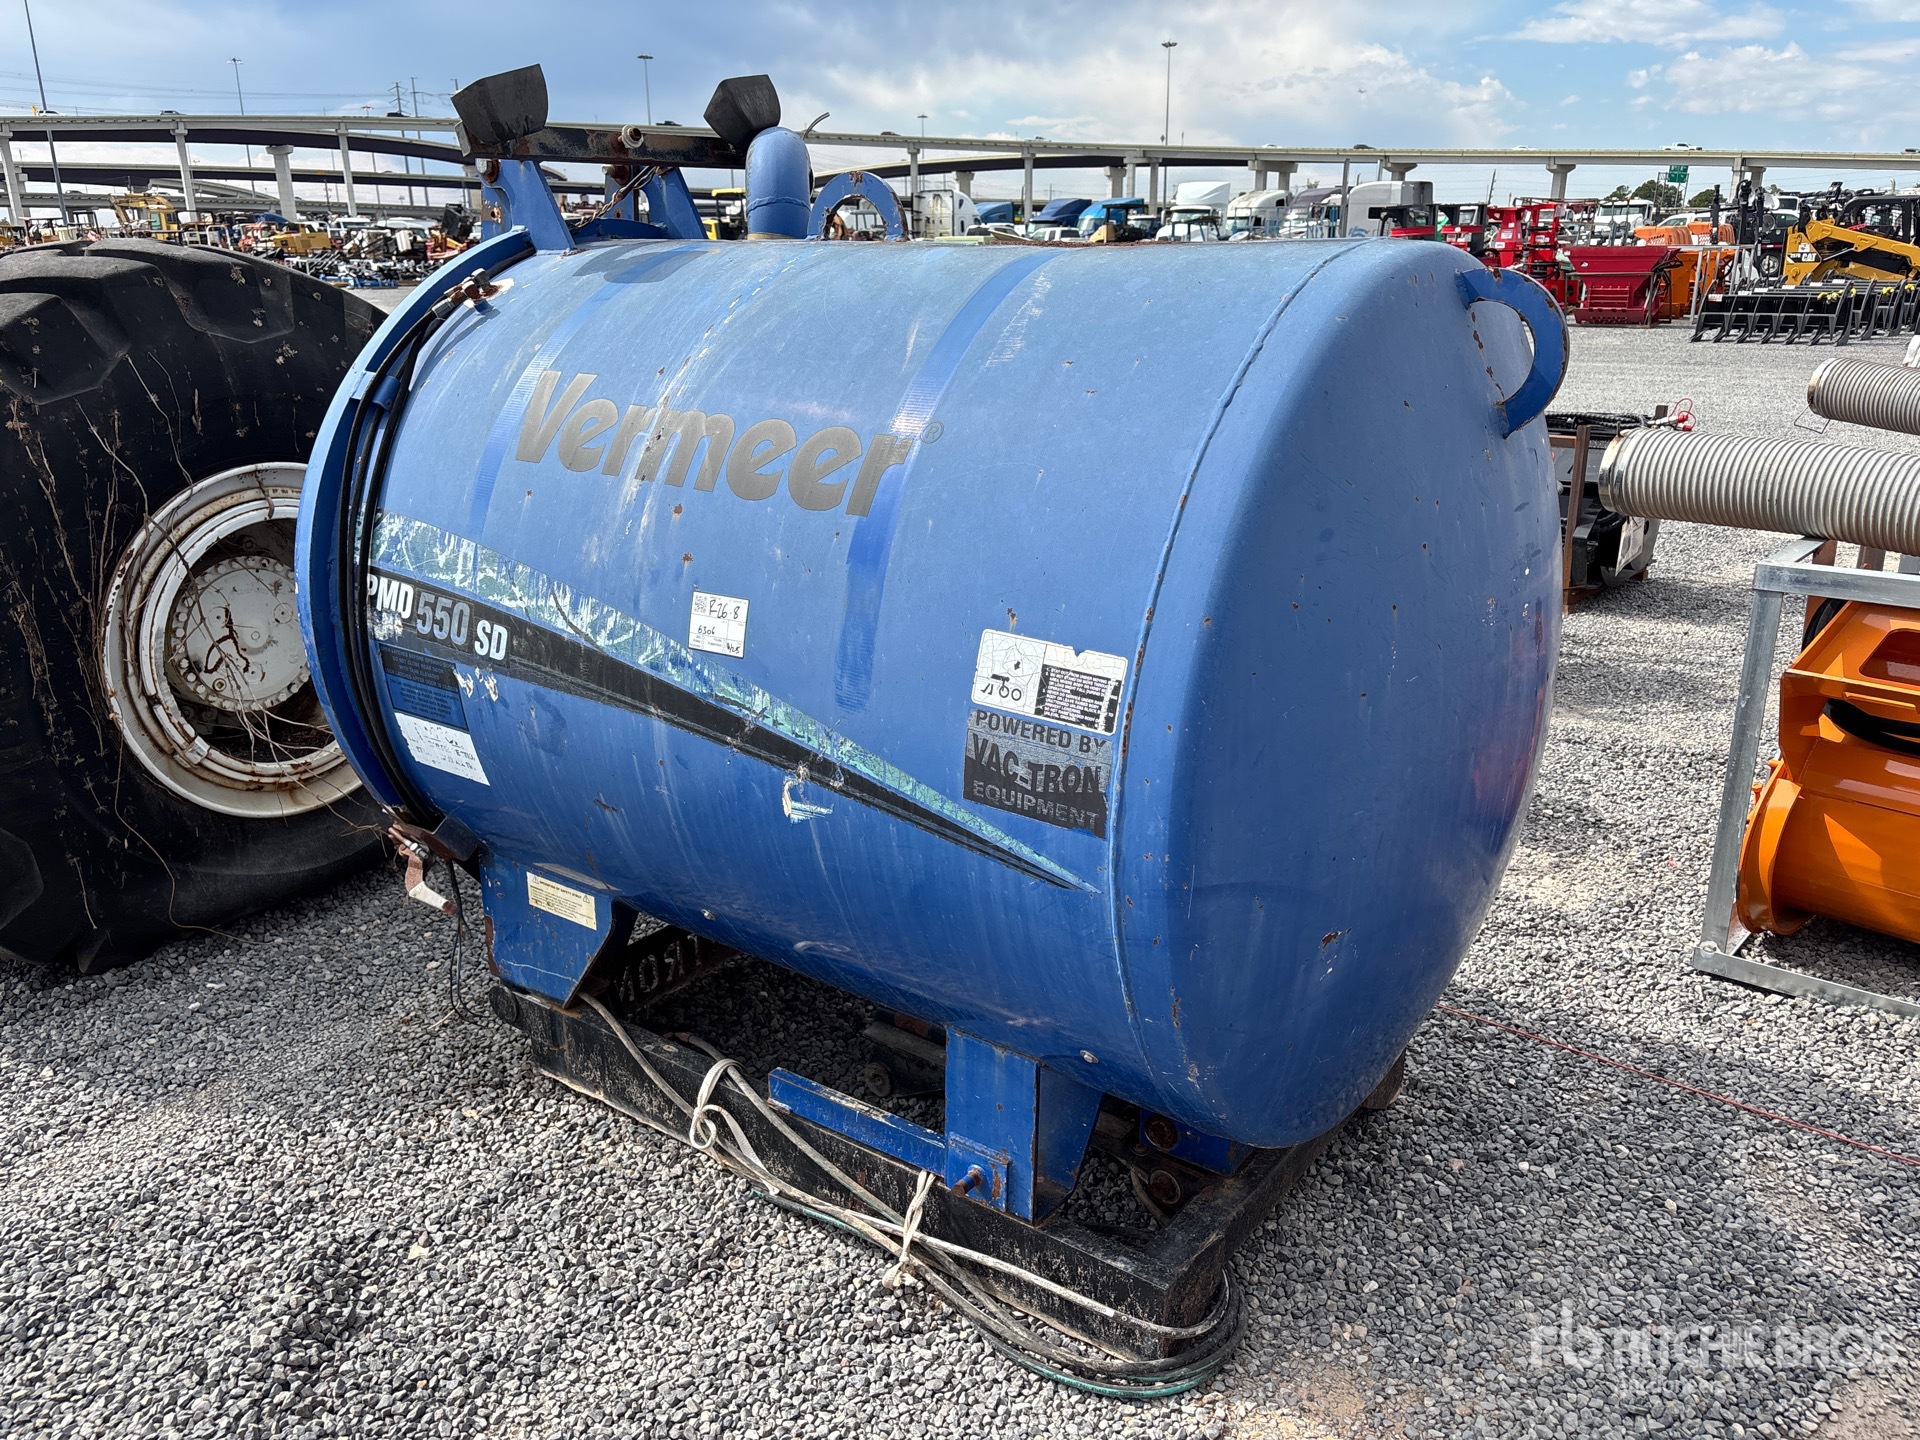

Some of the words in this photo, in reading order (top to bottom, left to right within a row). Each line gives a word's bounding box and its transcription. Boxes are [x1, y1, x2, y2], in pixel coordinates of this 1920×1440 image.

[1801, 253, 1817, 262] CAT
[515, 370, 914, 518] Vermeer
[416, 592, 471, 646] 550
[474, 619, 508, 661] SD
[975, 710, 1071, 748] POWERED
[1080, 735, 1108, 755] BY
[972, 733, 1102, 793] VAC-TRON
[972, 780, 1099, 829] EQUIPMENT
